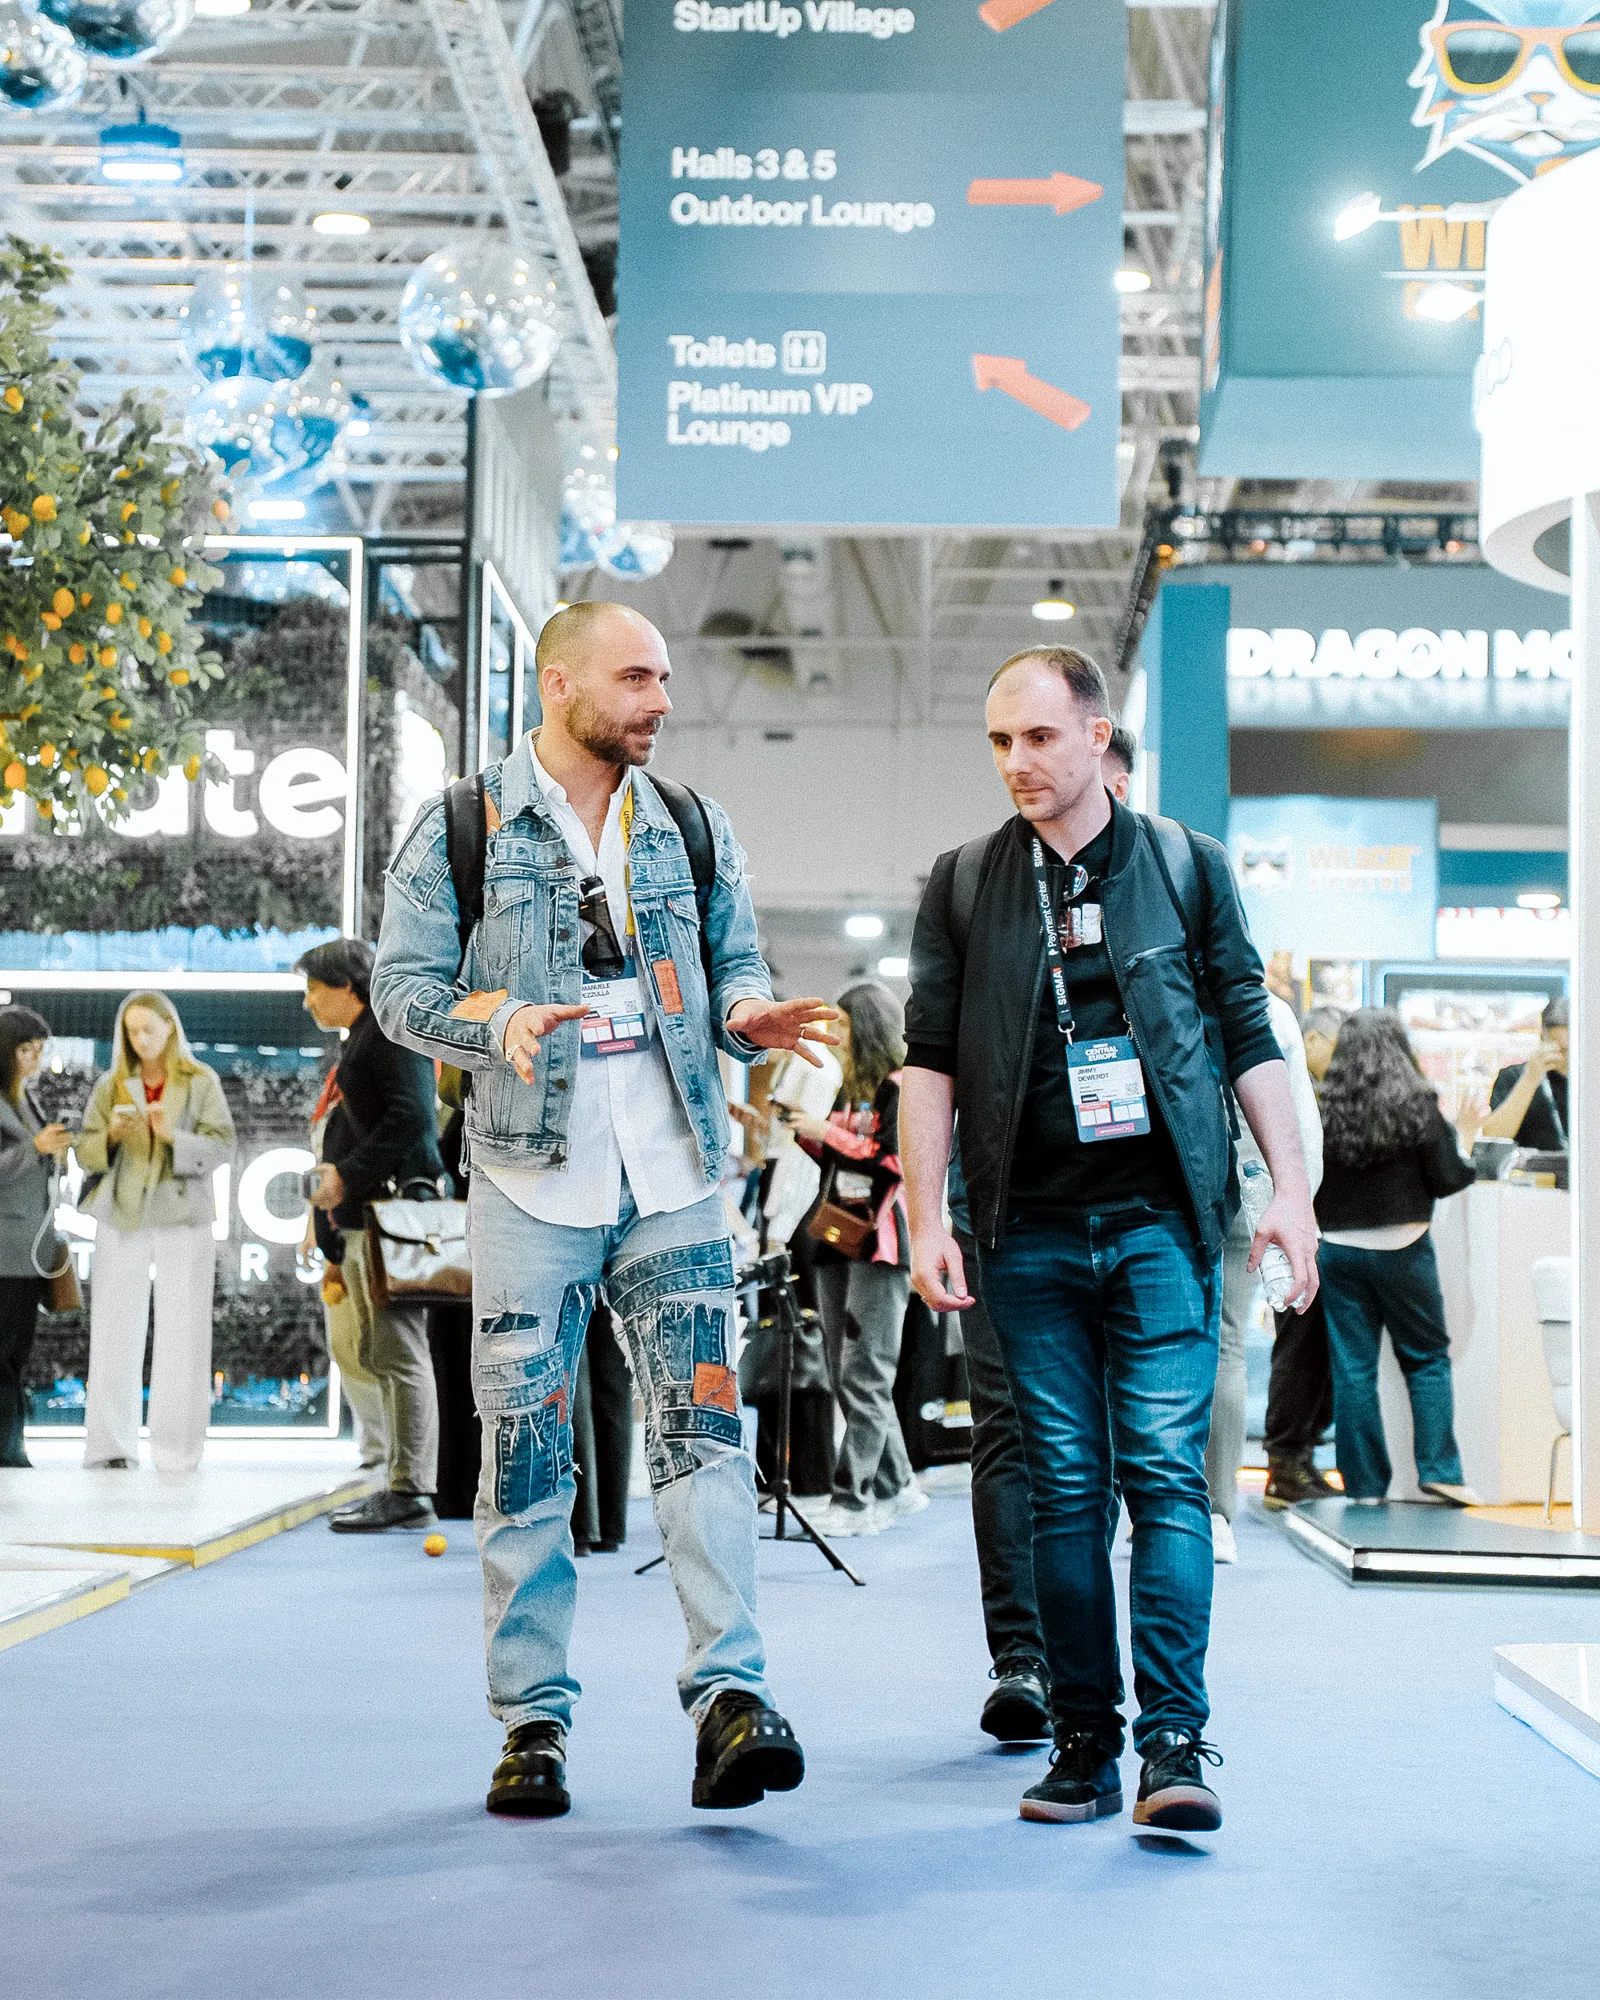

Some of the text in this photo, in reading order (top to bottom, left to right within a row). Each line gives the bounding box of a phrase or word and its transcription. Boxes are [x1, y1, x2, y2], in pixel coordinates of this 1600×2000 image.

[674, 0, 915, 39] StartUp Village
[671, 146, 837, 181] Halls 3 & 5
[670, 192, 936, 233] Outdoor Lounge
[668, 335, 777, 368] Toilets
[668, 381, 874, 416] Platinum VIP
[668, 413, 792, 452] Lounge
[1227, 627, 1489, 679] DRAGON
[1032, 838, 1043, 868] SIGMA
[1039, 880, 1057, 947] Payment Center
[1053, 969, 1068, 1006] SIGMA
[1085, 1045, 1119, 1056] CENTRAL
[1088, 1052, 1118, 1062] EUROPE
[1078, 1067, 1097, 1075] JIMMY
